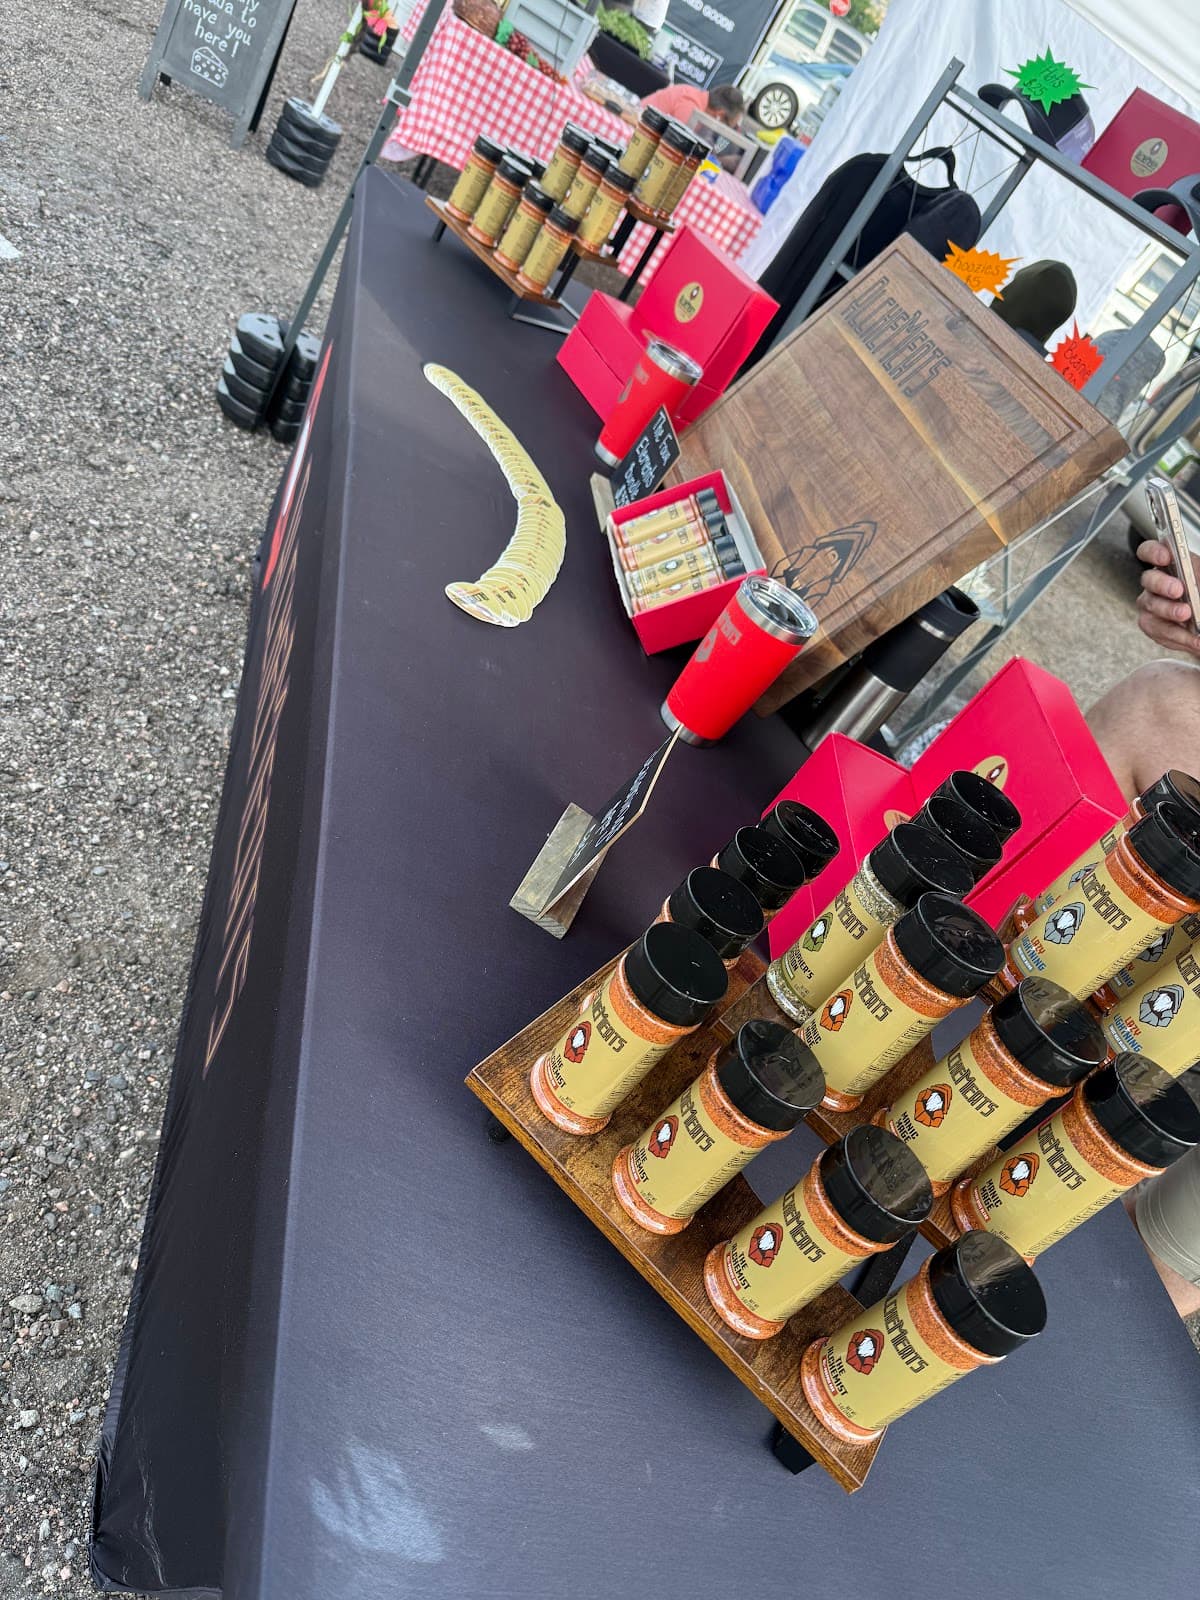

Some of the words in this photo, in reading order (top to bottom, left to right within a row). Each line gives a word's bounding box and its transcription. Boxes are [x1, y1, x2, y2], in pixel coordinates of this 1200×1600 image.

[240, 6, 257, 28] to
[224, 22, 252, 47] you
[554, 1054, 565, 1070] THE
[895, 1119, 911, 1144] MAGE
[902, 1111, 919, 1140] MANIC
[979, 1184, 996, 1212] MAGE
[985, 1177, 1003, 1209] MANIC
[737, 1250, 749, 1270] THE
[827, 1345, 849, 1397] ALCHEMIST
[836, 1354, 847, 1376] THE
